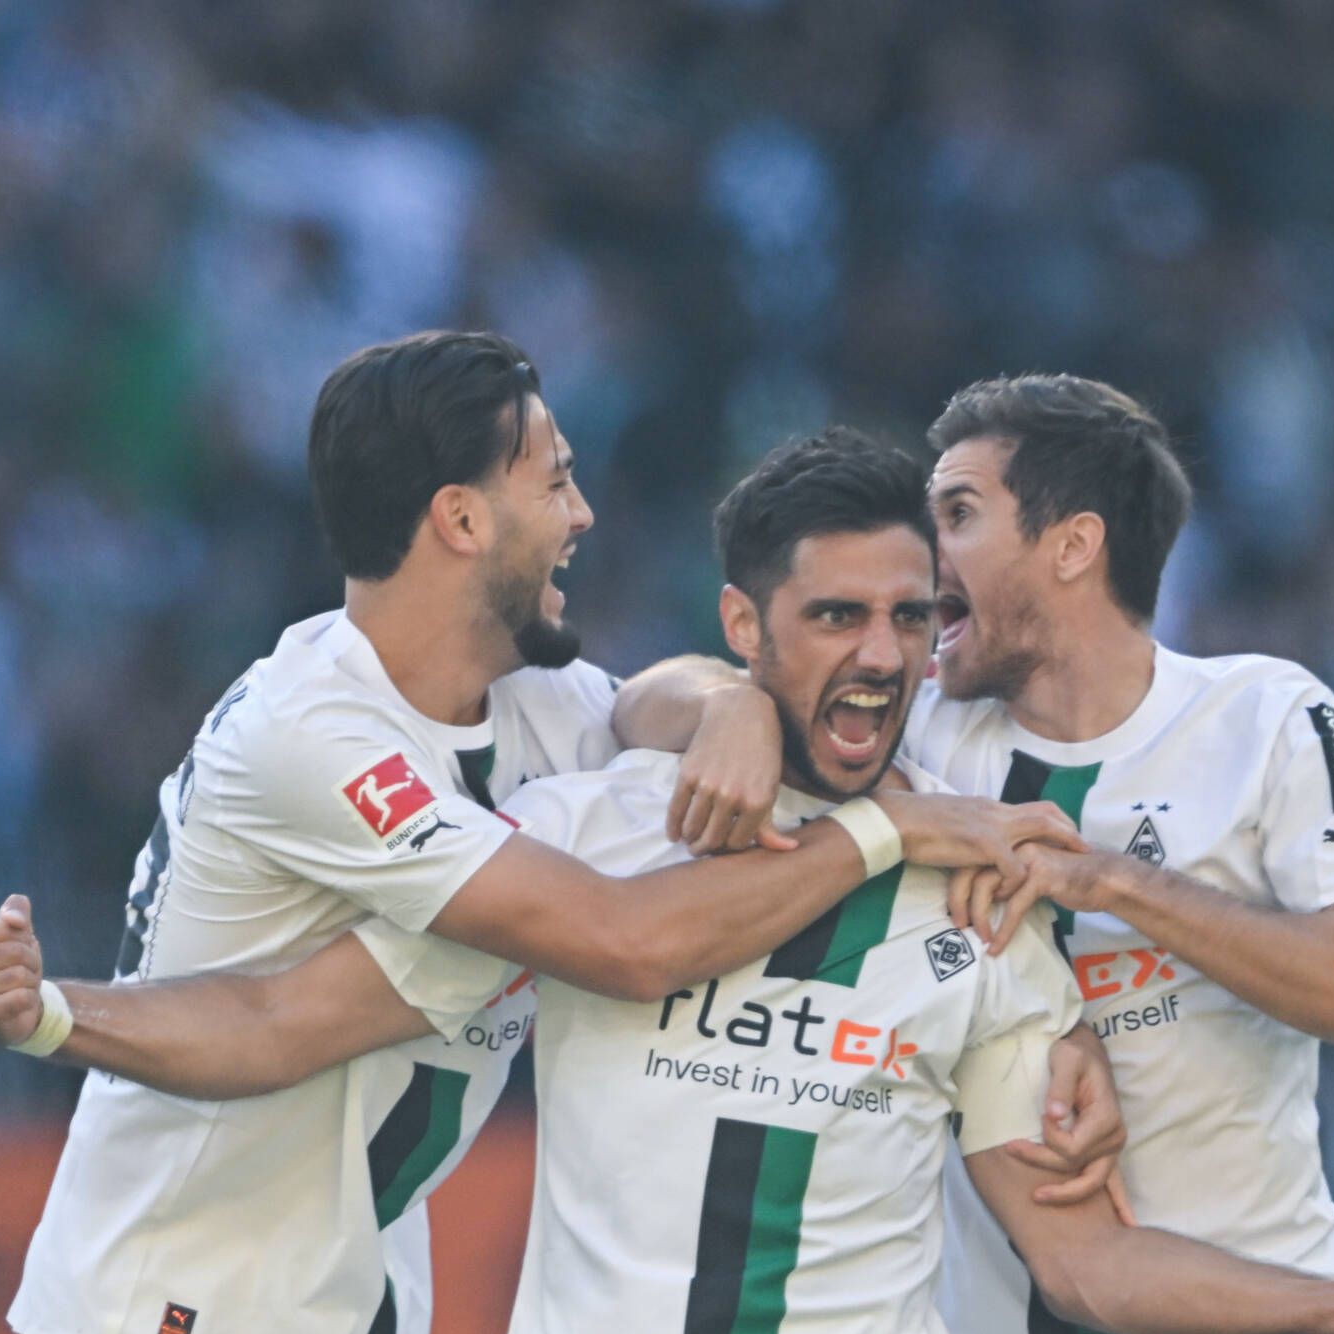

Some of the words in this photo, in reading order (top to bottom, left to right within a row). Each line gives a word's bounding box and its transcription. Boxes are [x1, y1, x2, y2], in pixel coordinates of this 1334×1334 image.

[1093, 994, 1179, 1039] urself
[645, 1048, 743, 1091] Invest
[751, 1066, 779, 1096] in
